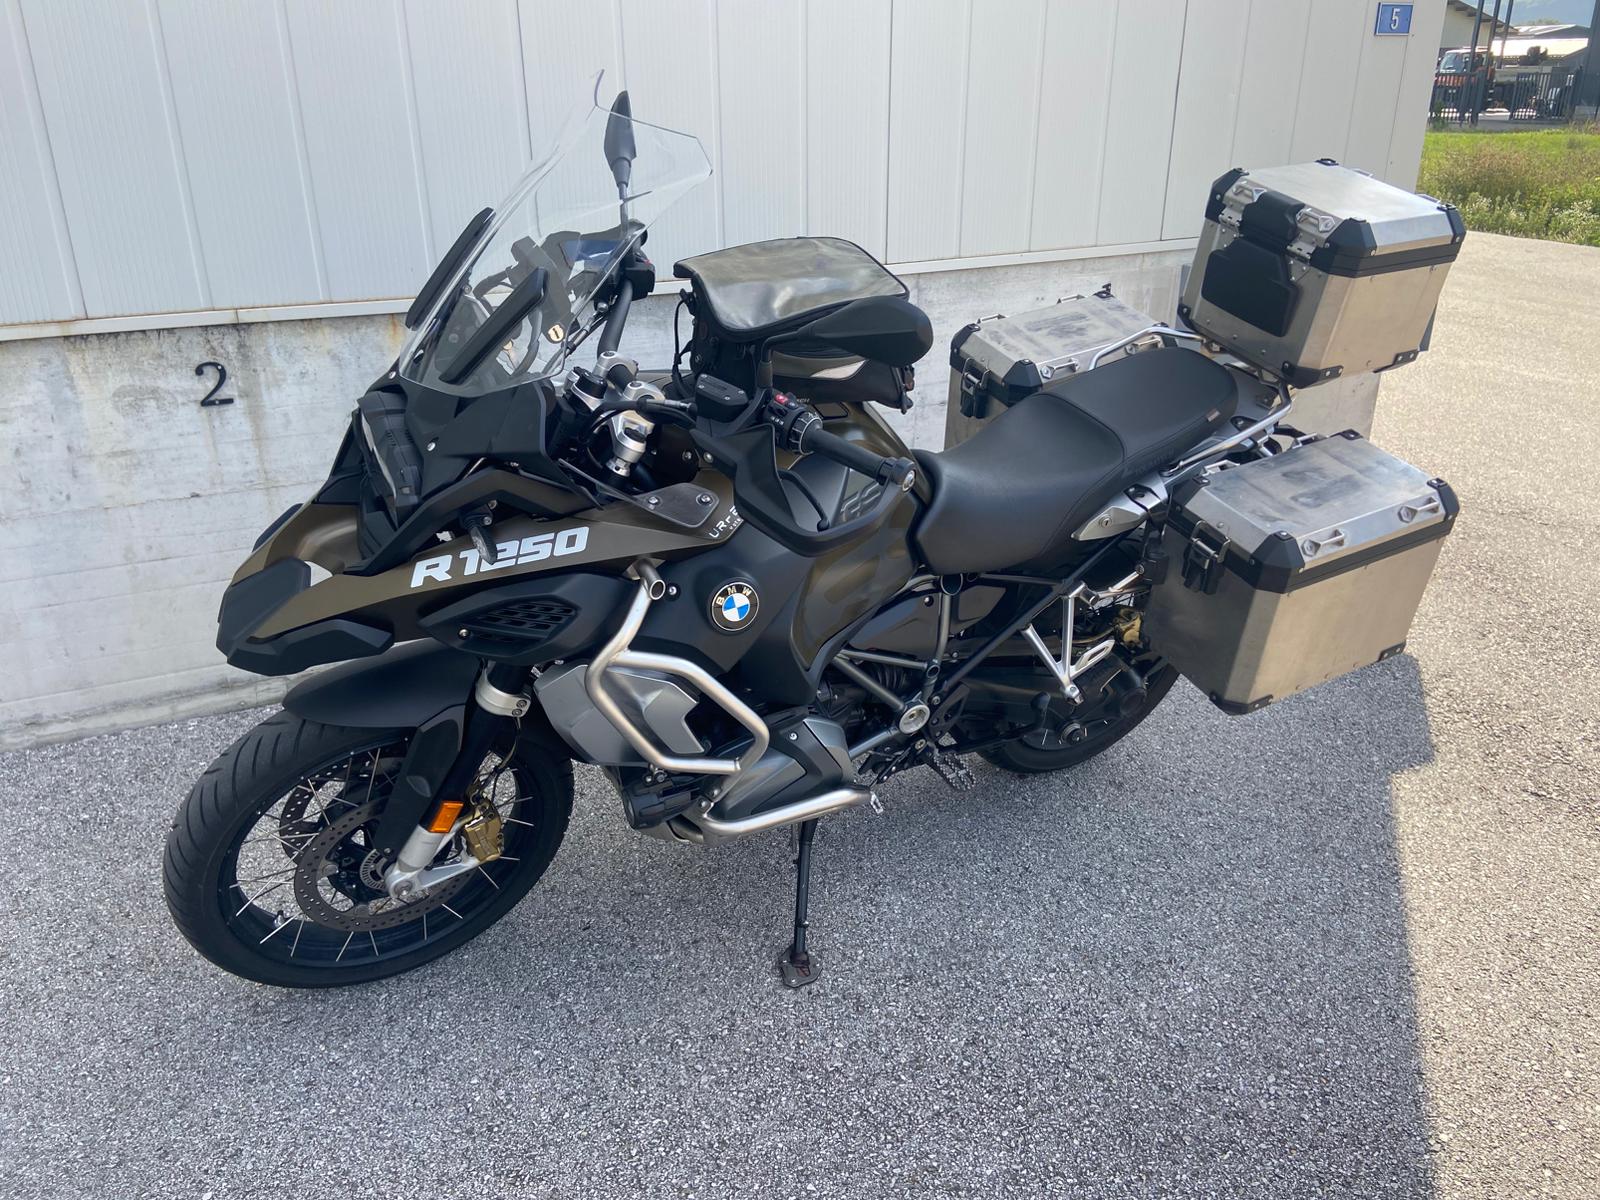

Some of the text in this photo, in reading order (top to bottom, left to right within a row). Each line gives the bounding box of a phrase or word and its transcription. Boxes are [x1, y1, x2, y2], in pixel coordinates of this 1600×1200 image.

[1390, 7, 1401, 30] 5
[195, 361, 234, 407] 2
[410, 526, 590, 588] R 1250
[715, 585, 752, 606] BMW
